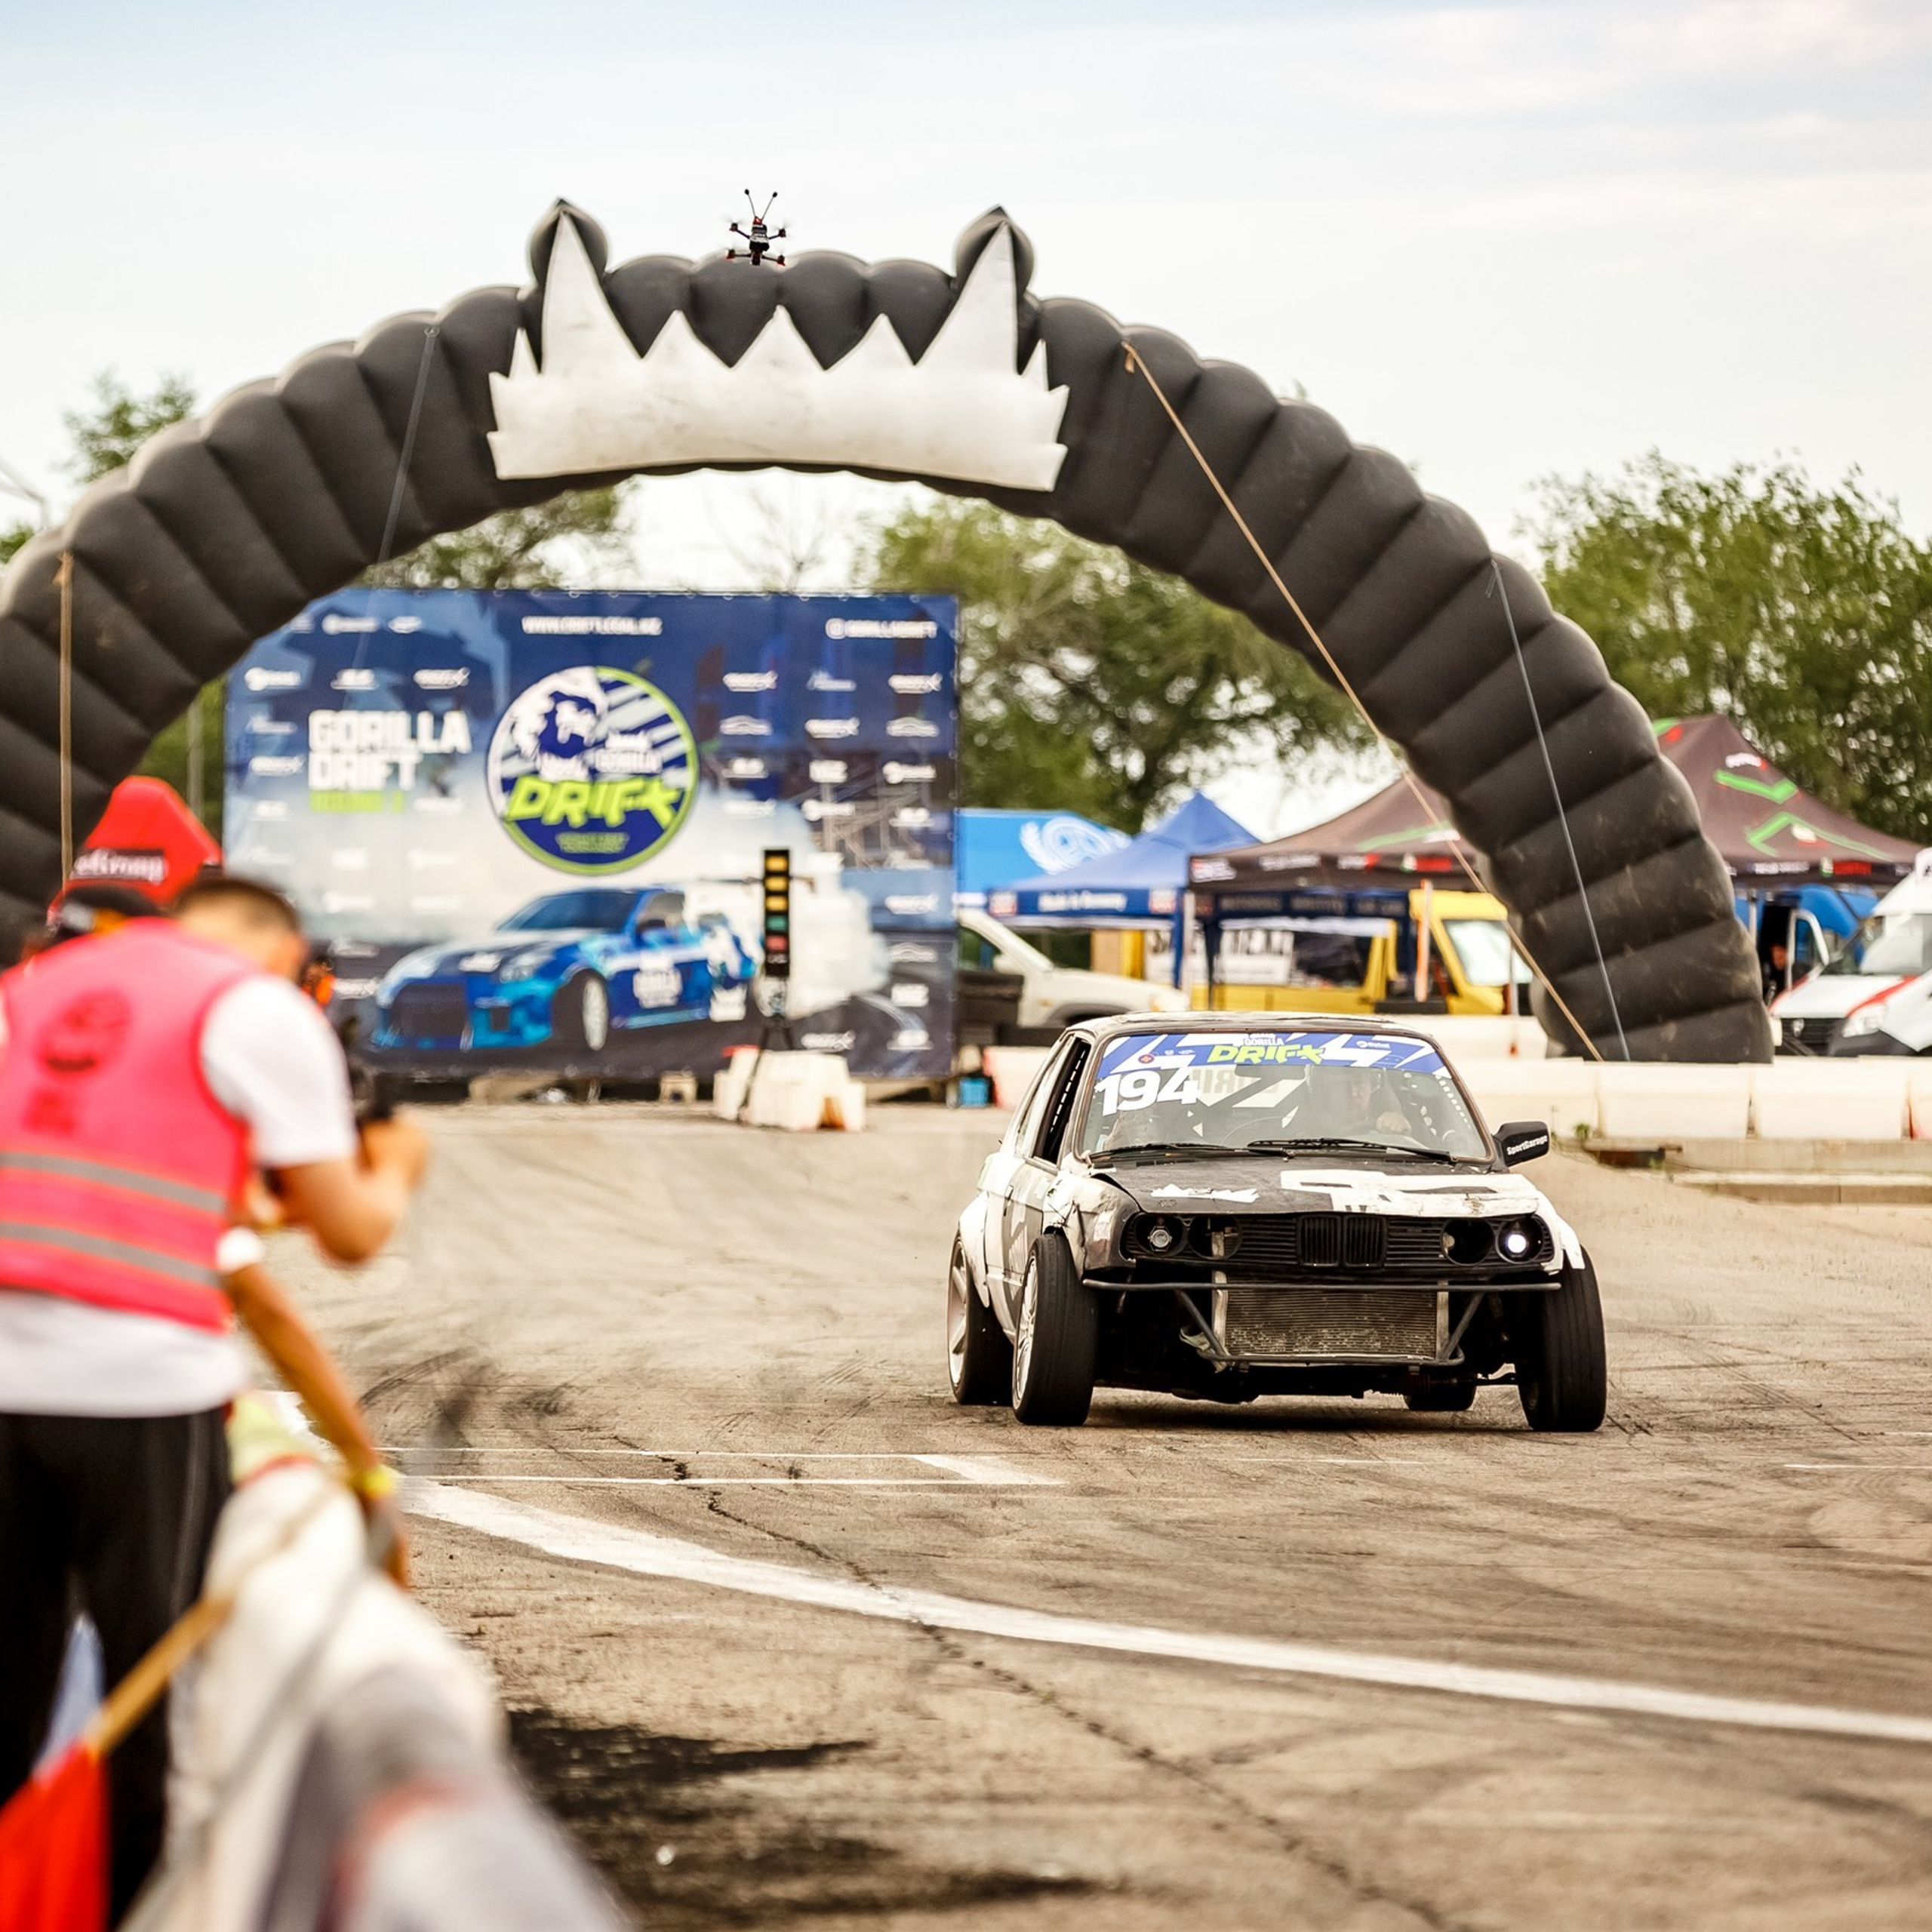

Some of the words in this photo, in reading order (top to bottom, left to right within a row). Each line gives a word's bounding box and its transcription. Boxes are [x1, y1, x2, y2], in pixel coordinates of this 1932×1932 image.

[309, 709, 472, 753] GORILLA
[308, 752, 423, 790] DRIFT
[1244, 1038, 1284, 1046] GORILLA
[1094, 1066, 1199, 1116] 194
[1506, 1135, 1548, 1155] SportGarage
